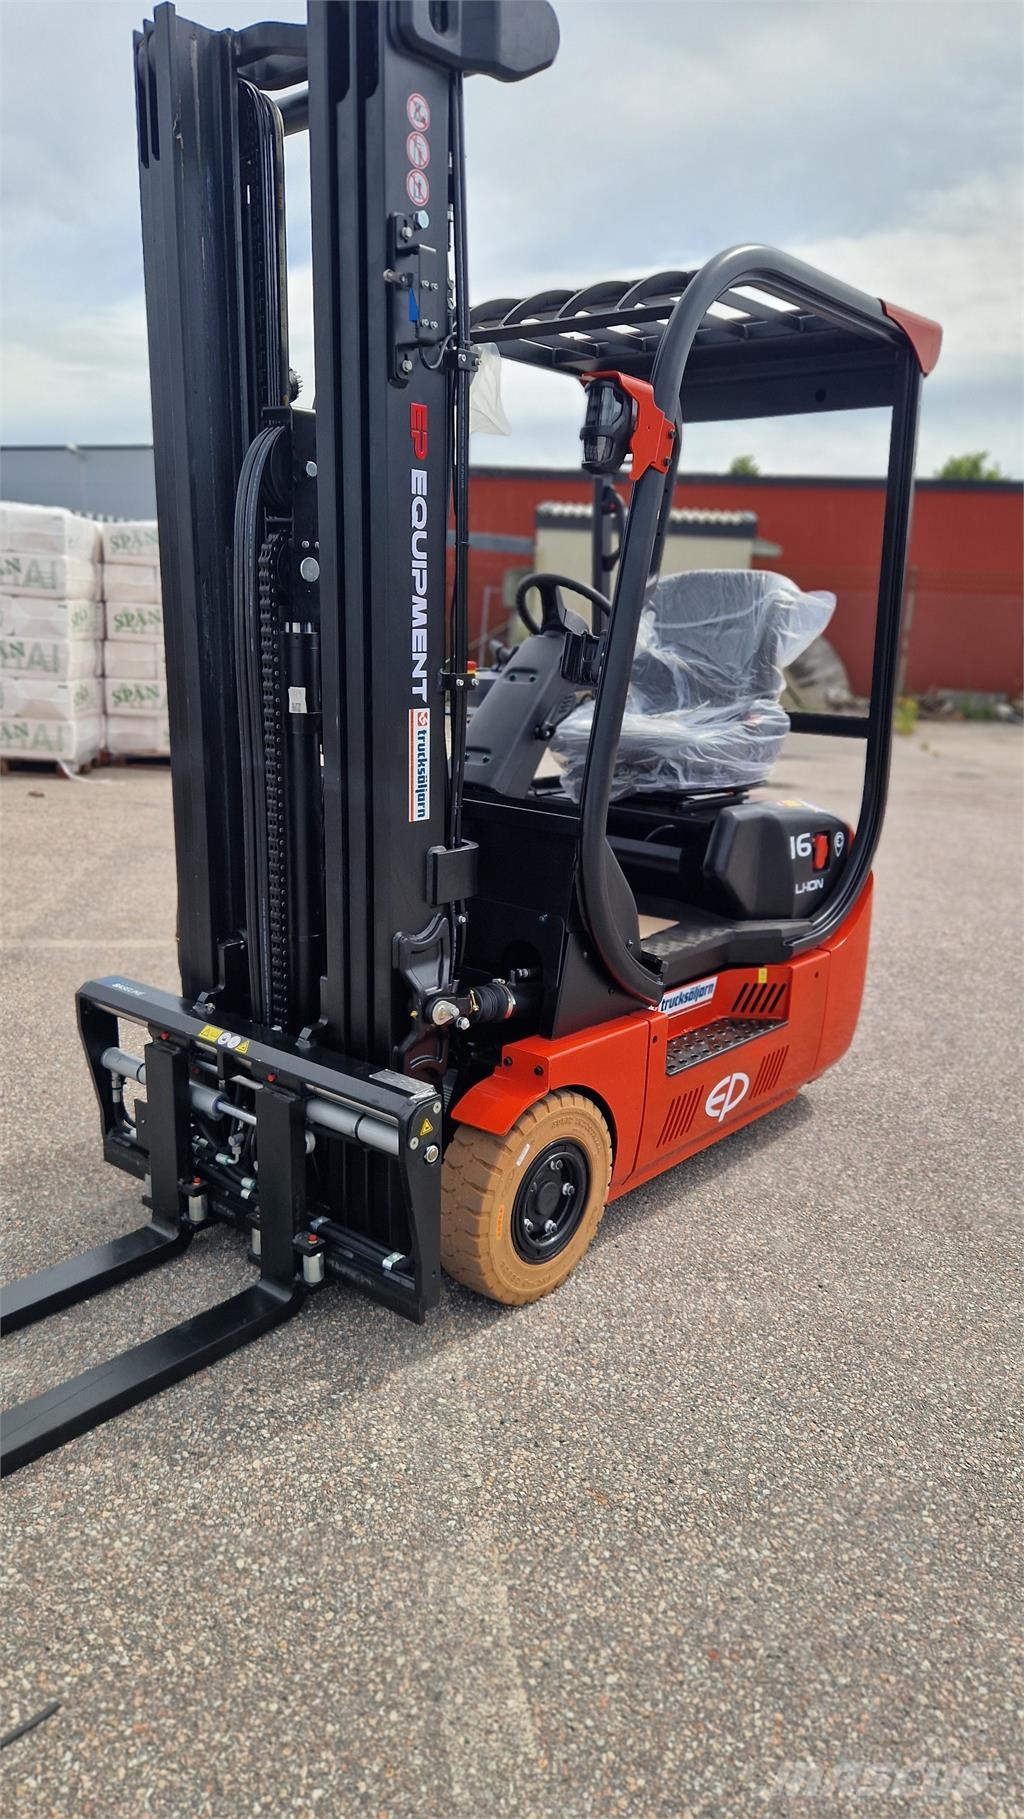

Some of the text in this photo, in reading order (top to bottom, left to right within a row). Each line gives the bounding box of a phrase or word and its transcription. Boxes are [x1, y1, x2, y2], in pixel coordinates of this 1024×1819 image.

[410, 402, 428, 703] EP EQUIPMENT
[416, 728, 428, 818] trucksäljarn
[790, 833, 812, 859] 16
[705, 1072, 750, 1122] EP
